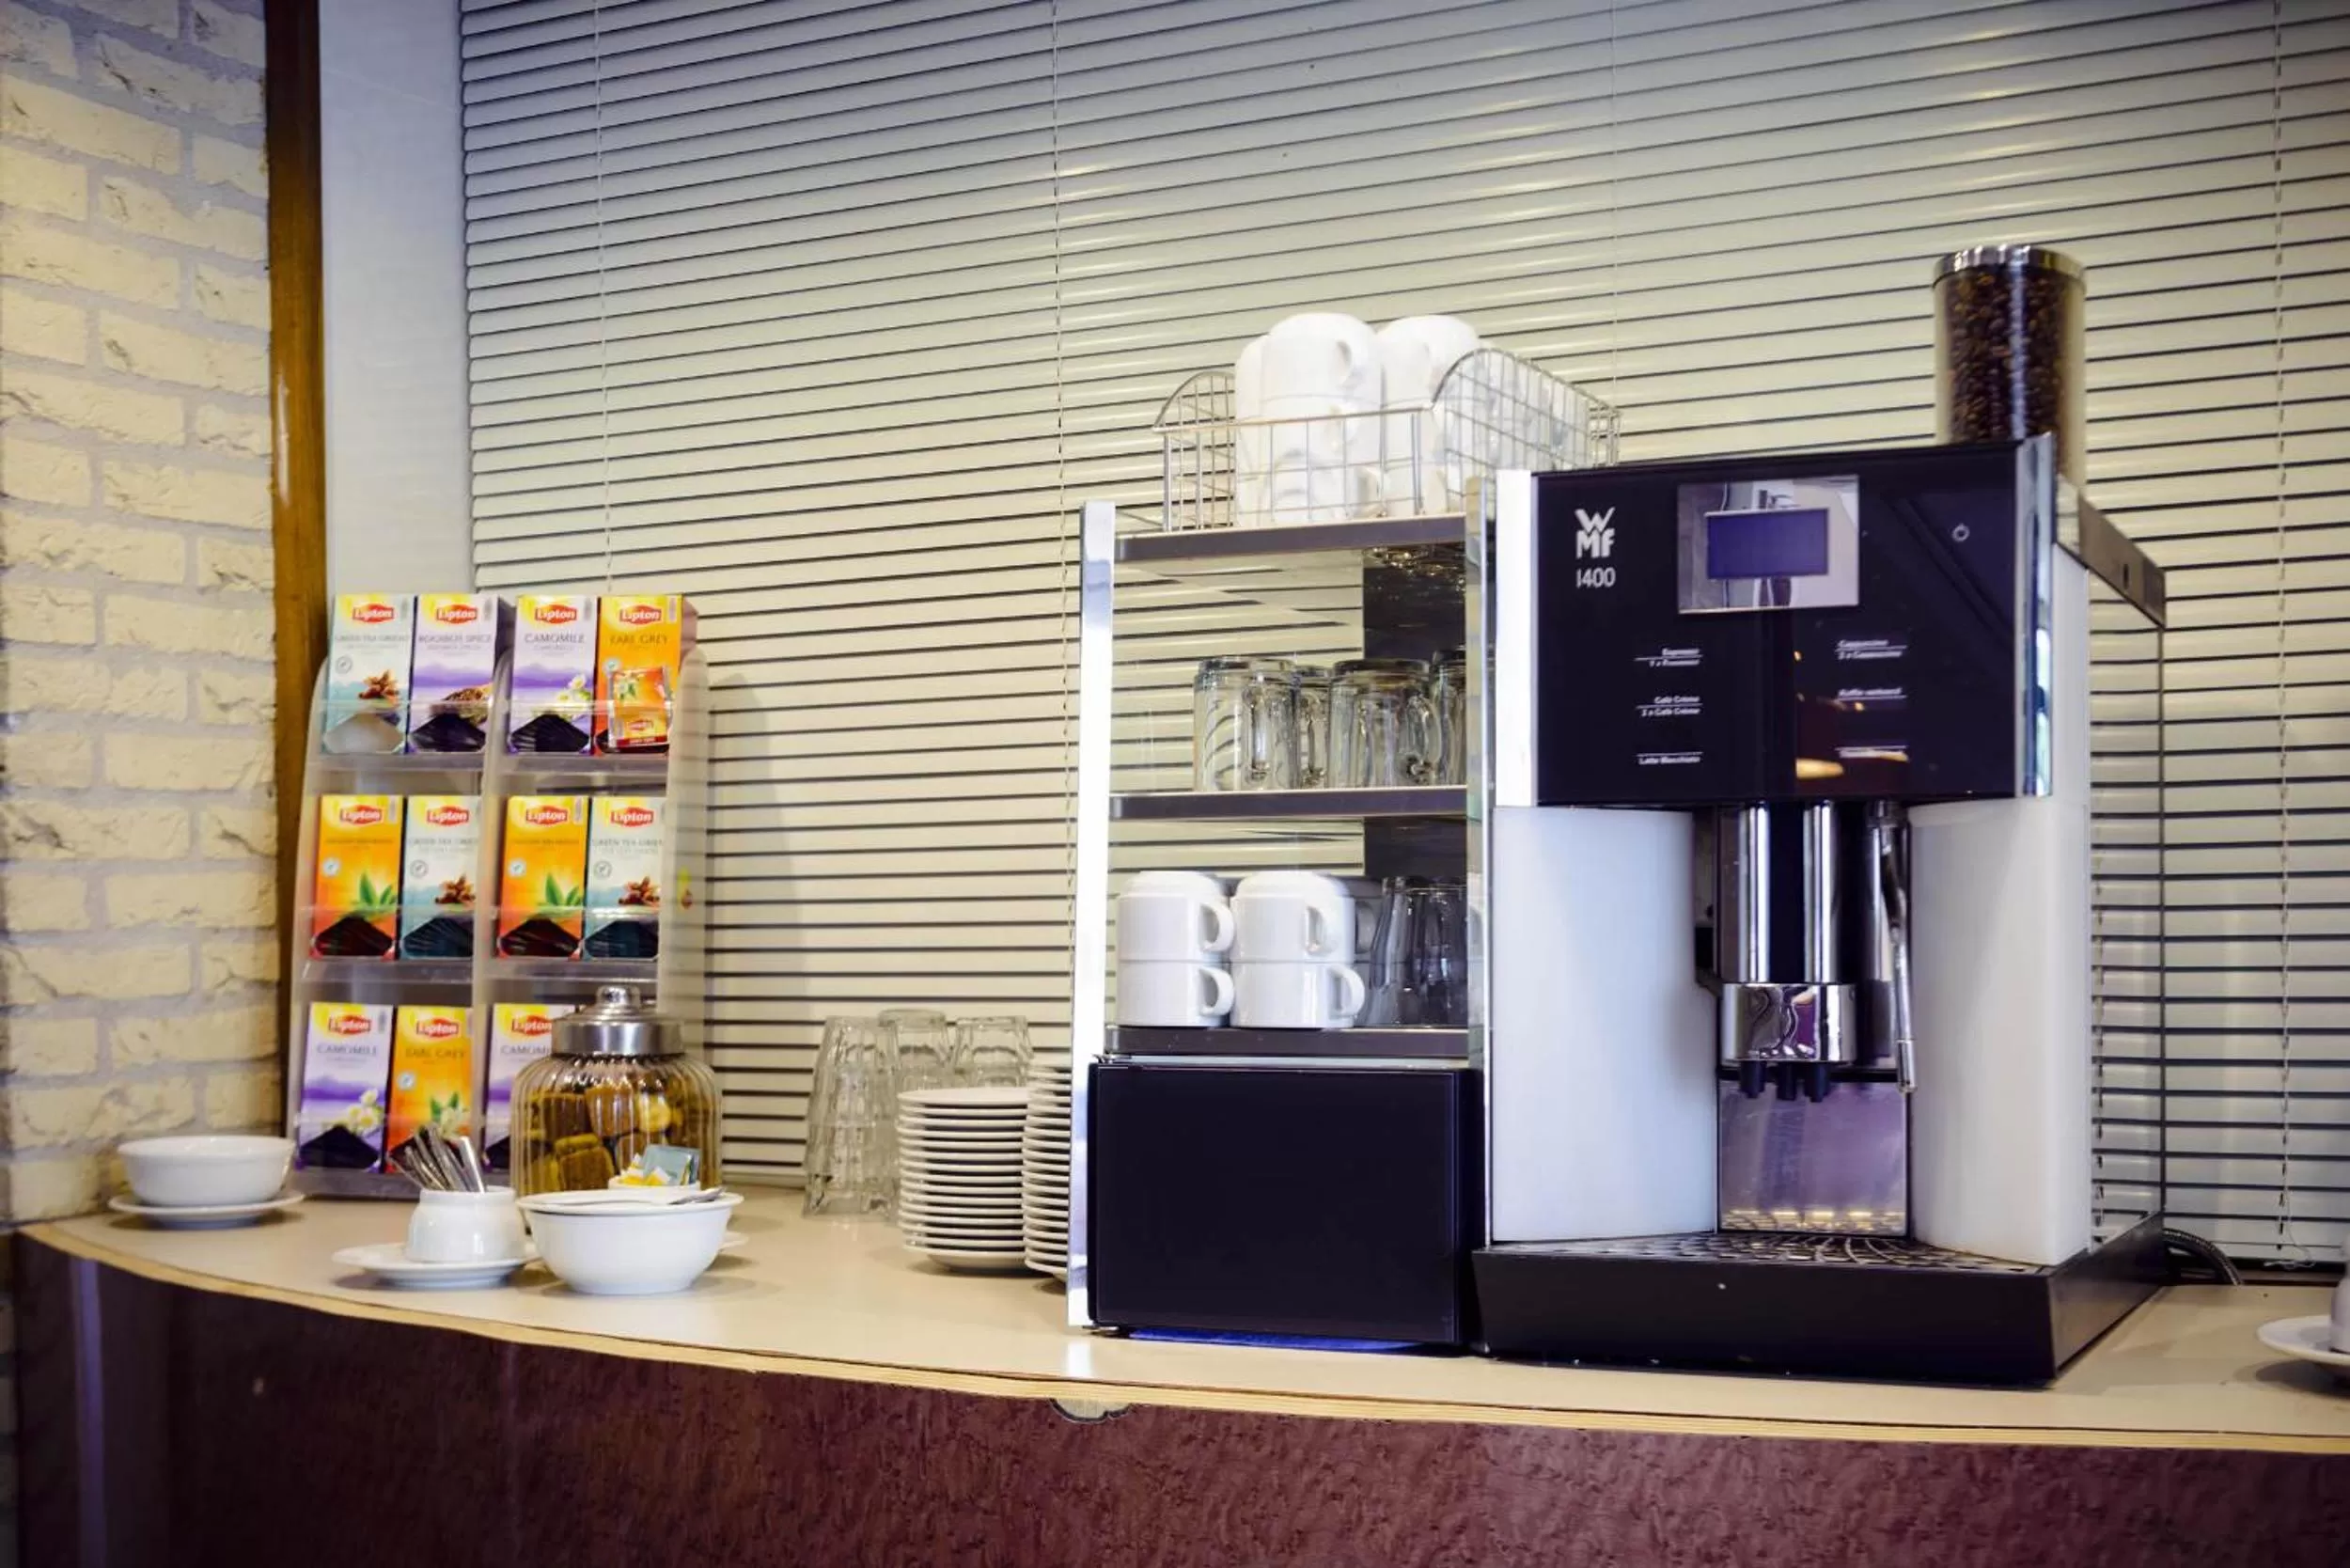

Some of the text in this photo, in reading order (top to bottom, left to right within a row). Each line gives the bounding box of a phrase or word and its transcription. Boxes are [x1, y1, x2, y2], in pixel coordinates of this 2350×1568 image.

[1574, 507, 1616, 558] WMF
[1576, 567, 1616, 588] 1400
[353, 606, 393, 621] Lipton
[437, 606, 477, 621] Lipton
[536, 606, 577, 621] Lipton
[619, 608, 662, 622] Lipton
[525, 633, 585, 643] CAMOMILE
[341, 808, 382, 822] Lipton
[428, 808, 468, 823] Lipton
[526, 808, 568, 823] Lipton
[612, 809, 653, 824] Lipton
[329, 1017, 372, 1033] Lipton
[416, 1021, 460, 1036] Lipton
[512, 1017, 553, 1033] Lipton
[317, 1044, 377, 1056] CAMOMILE
[500, 1044, 552, 1055] CAMOMI
